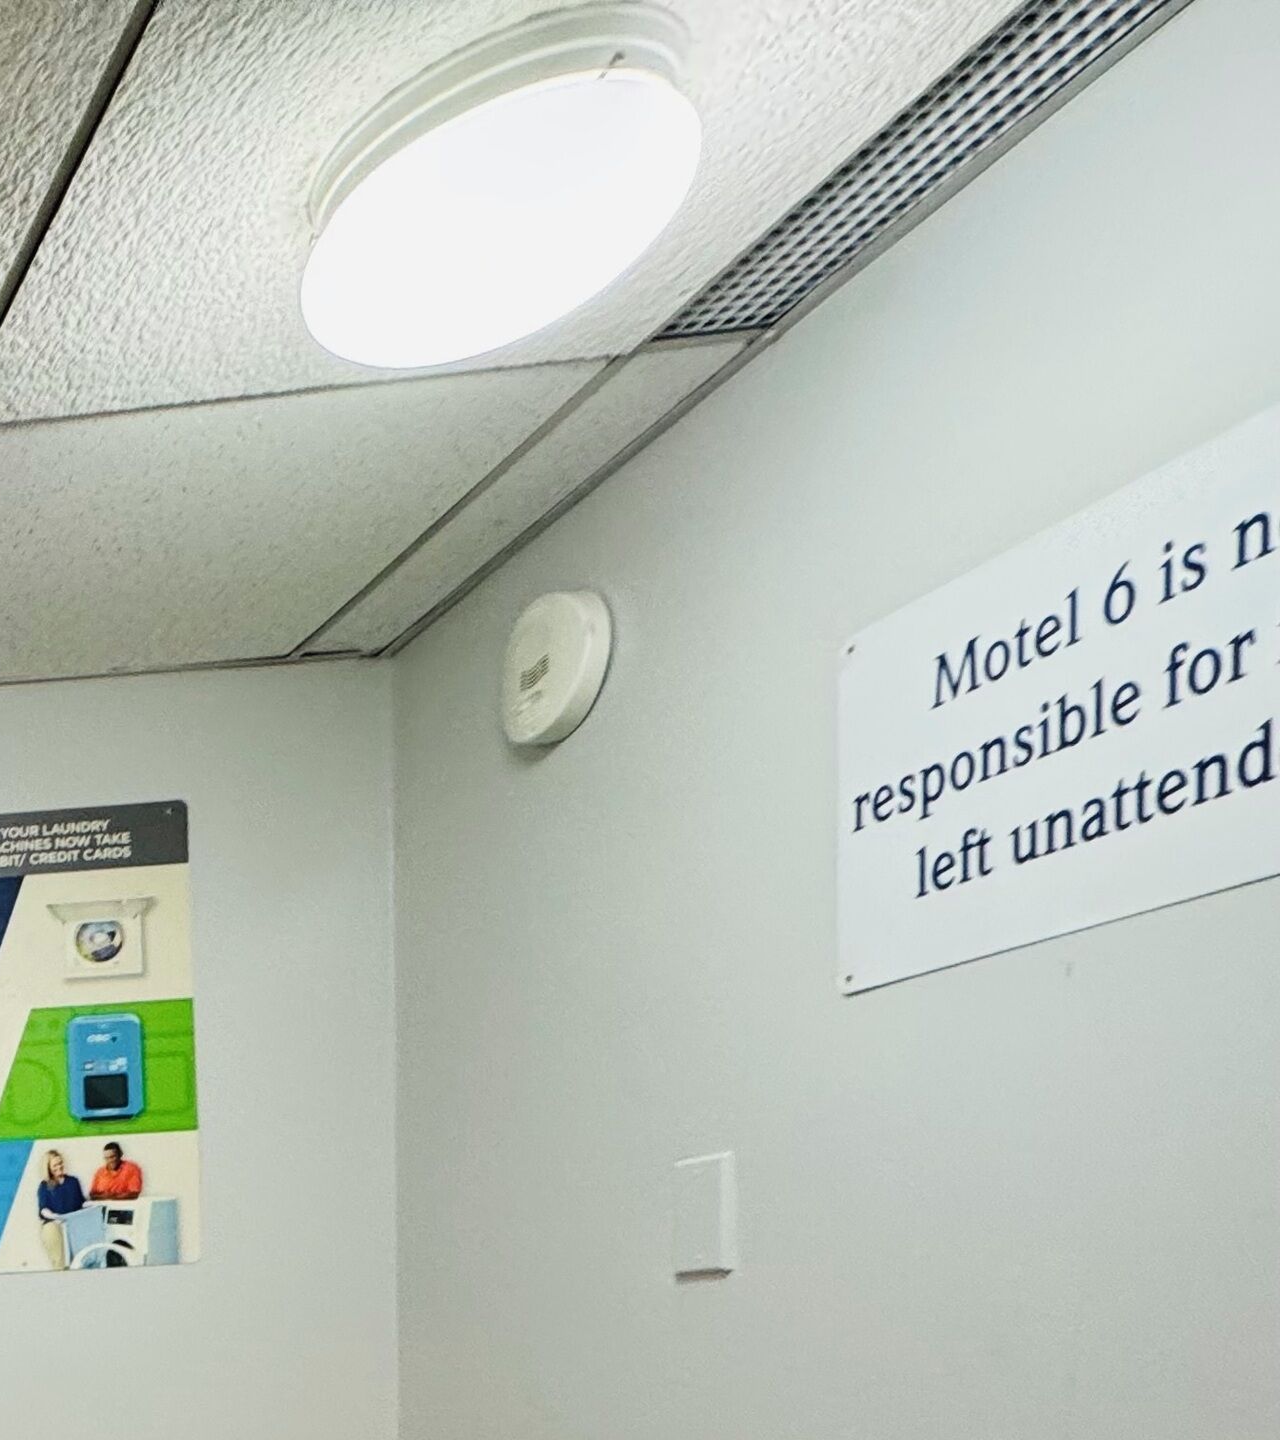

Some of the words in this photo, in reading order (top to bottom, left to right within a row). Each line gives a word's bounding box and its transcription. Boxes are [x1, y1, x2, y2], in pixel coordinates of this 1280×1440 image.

[929, 587, 1081, 711] Motel
[1102, 560, 1136, 626] 6
[1157, 540, 1206, 604] is
[1230, 511, 1280, 571] n
[851, 676, 1141, 834] responsible
[1161, 626, 1258, 710] for
[0, 825, 40, 840] YOUR
[41, 819, 110, 836] LAUNDRY
[28, 849, 81, 865] CREDIT
[83, 845, 132, 862] CARDS
[54, 835, 92, 850] NOW
[92, 831, 132, 847] TAKE
[915, 827, 994, 900] left
[1008, 717, 1280, 868] unattend
